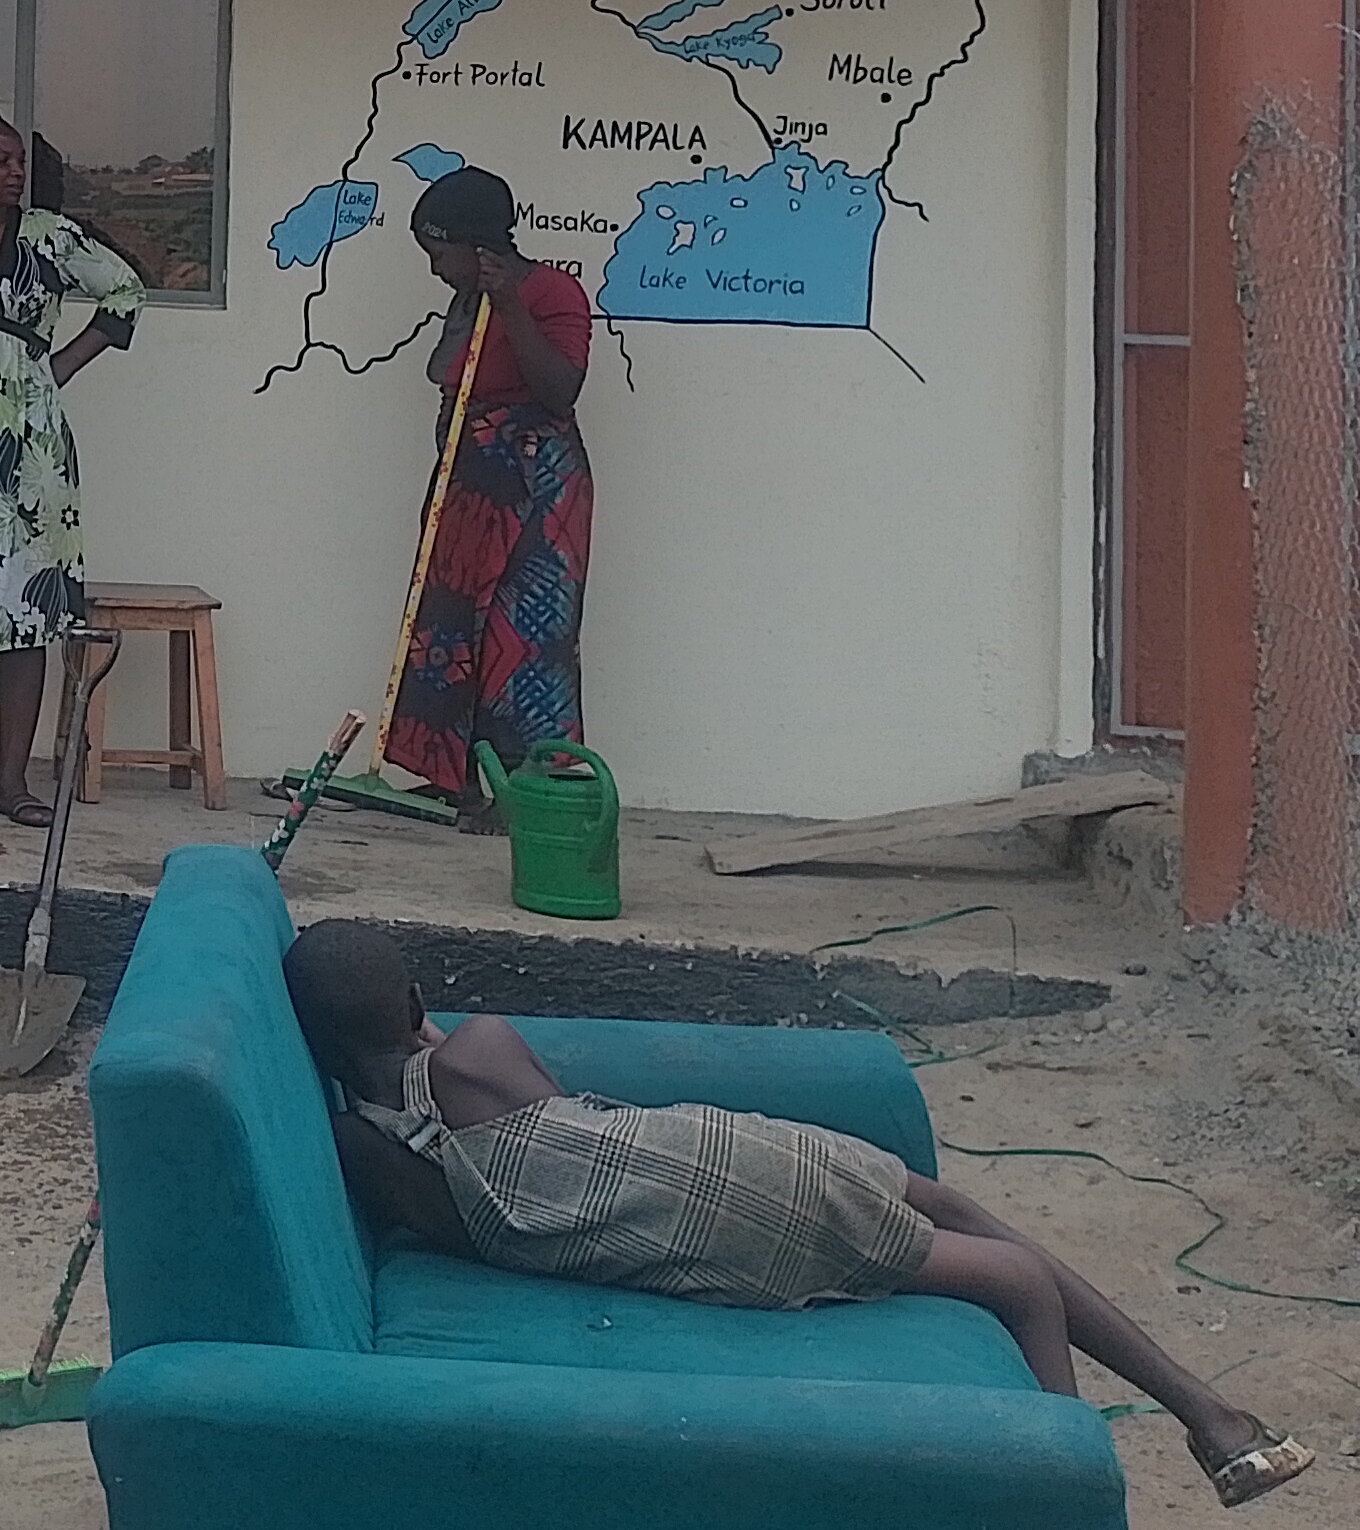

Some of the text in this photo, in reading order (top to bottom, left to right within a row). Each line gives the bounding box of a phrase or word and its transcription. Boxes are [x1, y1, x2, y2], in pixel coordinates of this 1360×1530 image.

[426, 17, 455, 44] Lake
[414, 61, 546, 88] Fort Portal
[827, 53, 913, 86] Mbale
[561, 114, 707, 152] KAMPALA
[343, 190, 372, 206] Lake
[338, 211, 384, 227] Edward
[422, 223, 448, 240] 2024
[639, 268, 805, 296] Lake Victoria
